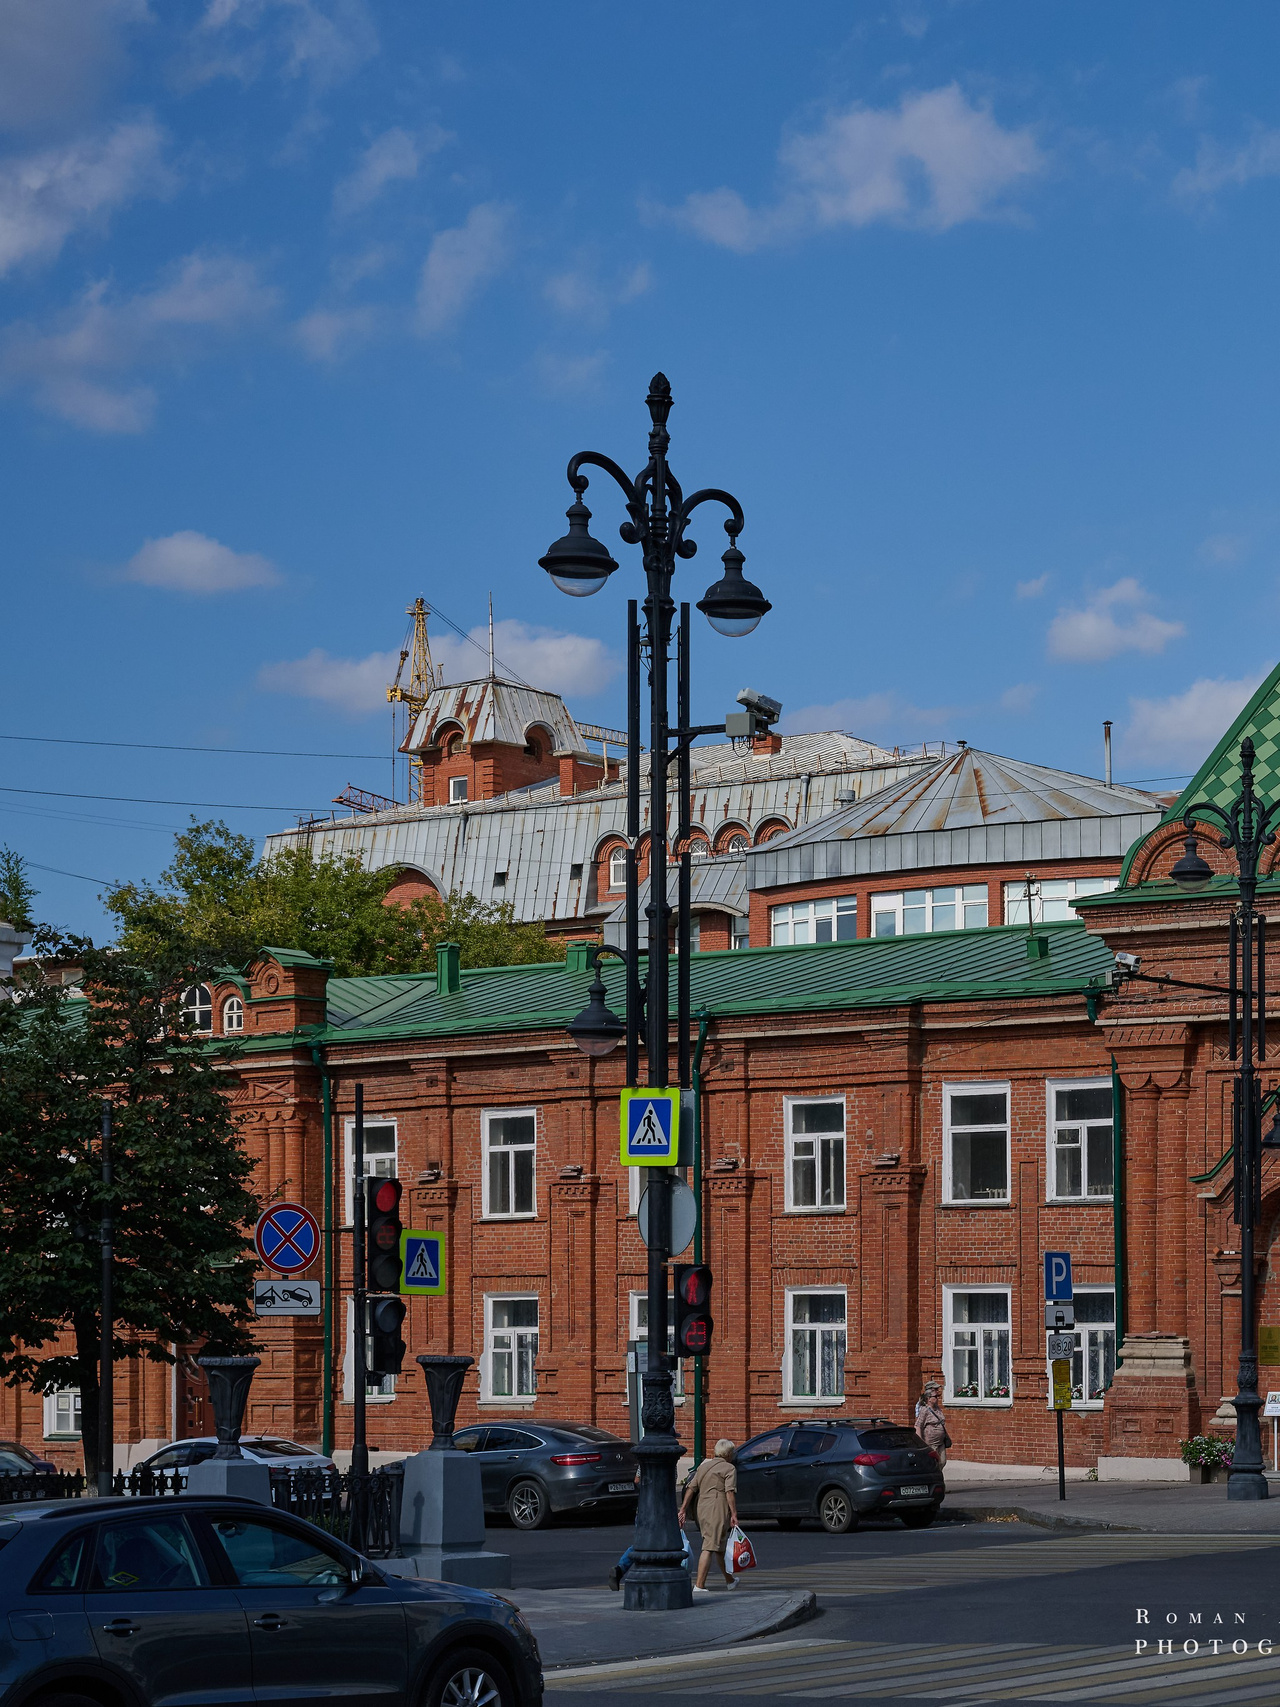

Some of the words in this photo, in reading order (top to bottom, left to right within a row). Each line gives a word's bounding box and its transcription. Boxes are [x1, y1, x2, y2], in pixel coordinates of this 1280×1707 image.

[1051, 1257, 1067, 1295] P
[685, 1321, 707, 1346] 23
[1063, 1341, 1071, 1351] 20
